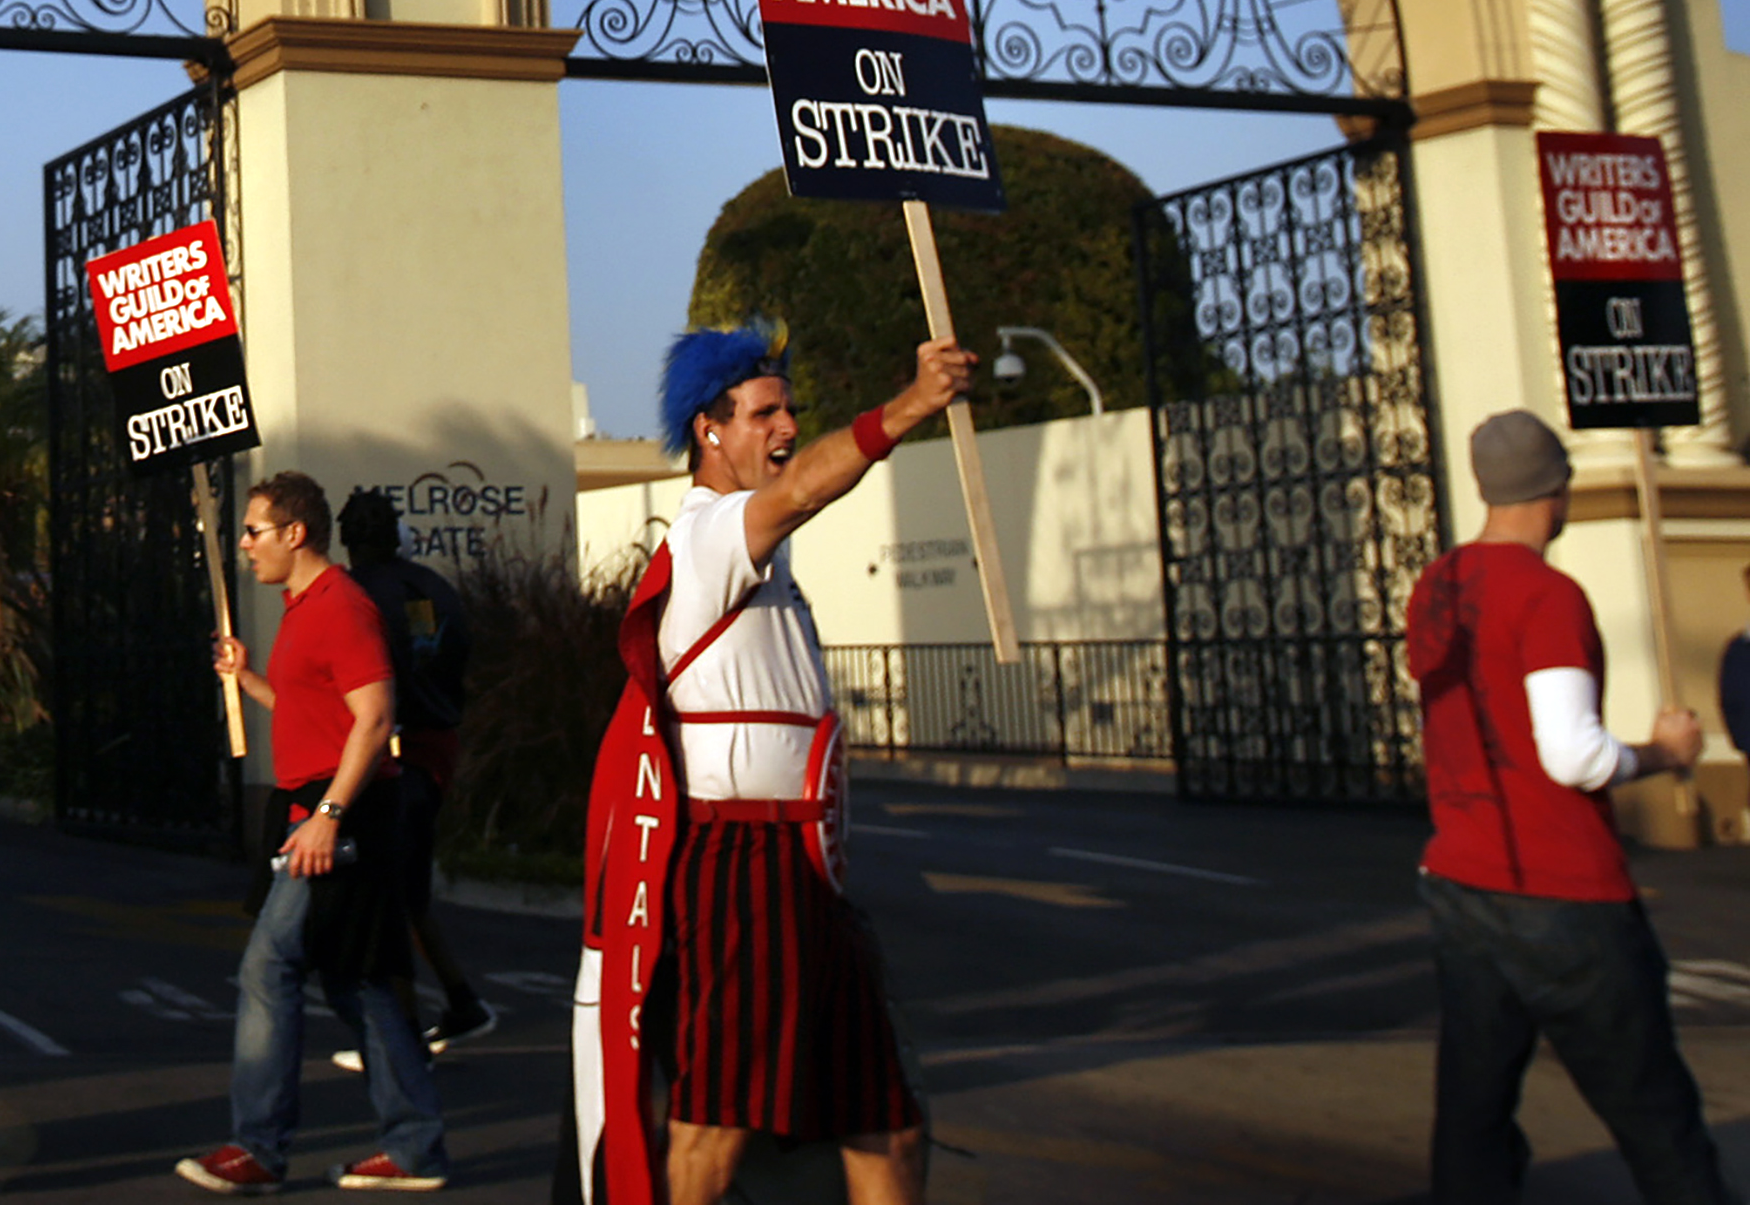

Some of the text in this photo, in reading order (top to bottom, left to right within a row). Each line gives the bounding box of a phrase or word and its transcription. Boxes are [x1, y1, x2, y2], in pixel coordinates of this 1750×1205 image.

[855, 48, 905, 97] ON
[792, 98, 990, 180] STRIKE
[1547, 152, 1661, 189] WRITERS
[1557, 190, 1662, 224] GUILD OF
[1557, 226, 1677, 261] AMERICA
[97, 240, 208, 298] WRITERS
[109, 275, 211, 324] GUILD OF
[1605, 297, 1644, 339] ON
[112, 296, 227, 355] AMERICA
[160, 362, 193, 399] ON
[1567, 344, 1695, 405] STRIKE
[127, 385, 249, 461] STRIKE
[354, 485, 525, 516] ELROSE
